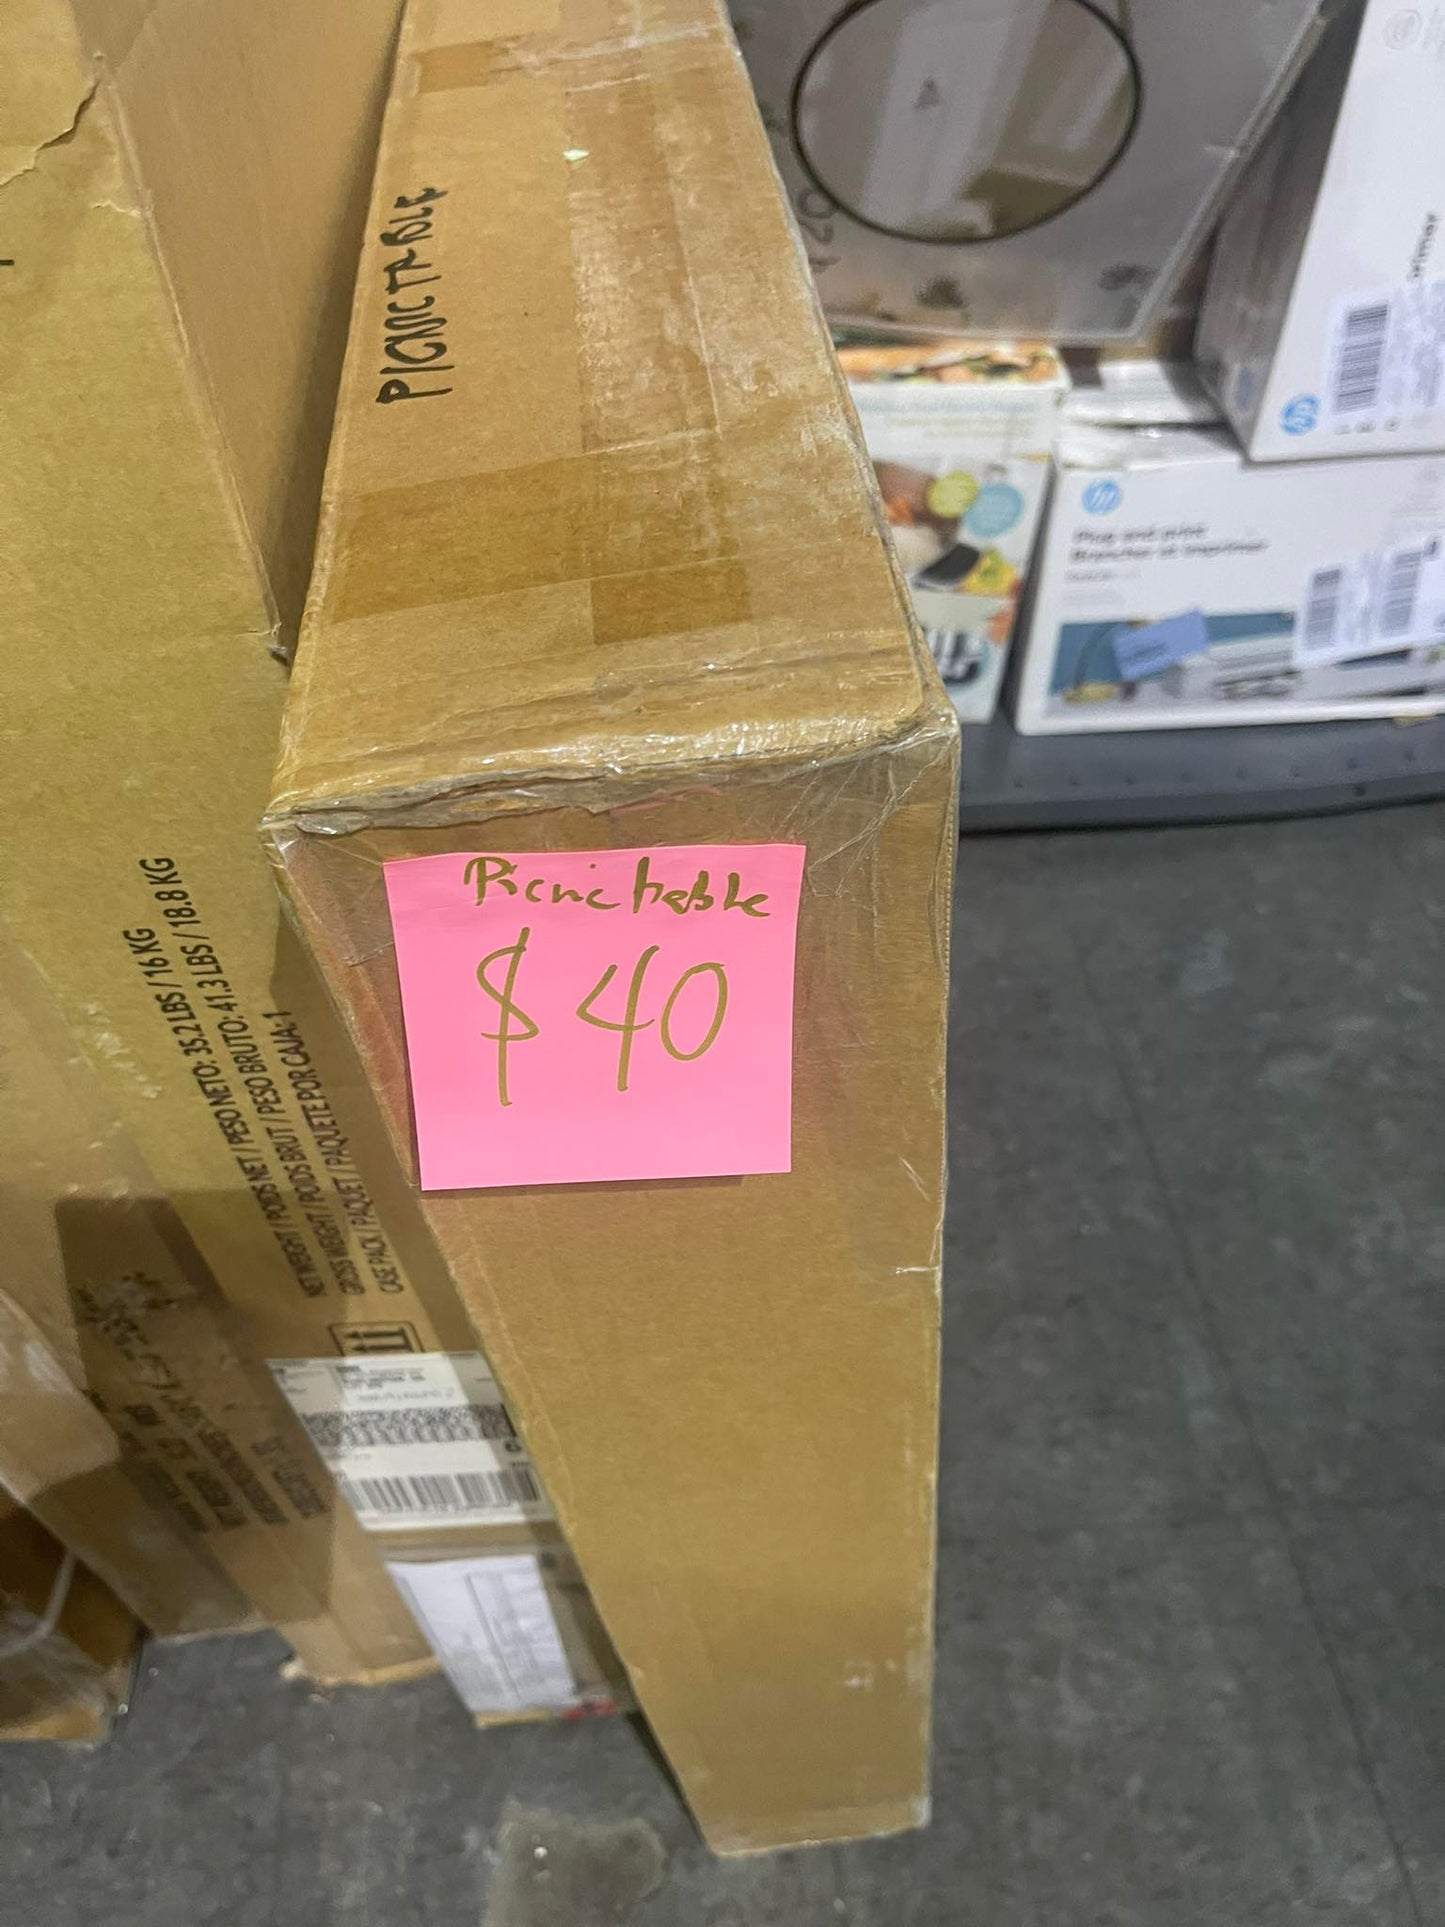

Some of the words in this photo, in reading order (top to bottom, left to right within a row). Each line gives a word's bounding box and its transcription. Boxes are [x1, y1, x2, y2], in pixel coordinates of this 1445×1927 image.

[139, 857, 182, 885] KG
[154, 889, 202, 928] 18.8
[122, 928, 163, 955] KG
[138, 957, 174, 978] 16
[180, 944, 223, 976] LBS
[155, 992, 196, 1022] LBS
[197, 978, 238, 1013] 41.3
[172, 1023, 213, 1057] 35.2
[218, 1015, 268, 1074] BRUTO:
[192, 1061, 237, 1107] NETO:
[244, 1077, 287, 1114] PESO
[288, 1068, 326, 1101] POR
[214, 1108, 256, 1145] PESO
[266, 1126, 307, 1162] BRUT
[301, 1101, 352, 1167] PAQUETE
[237, 1155, 273, 1182] NET
[332, 1176, 379, 1225] PAQUET
